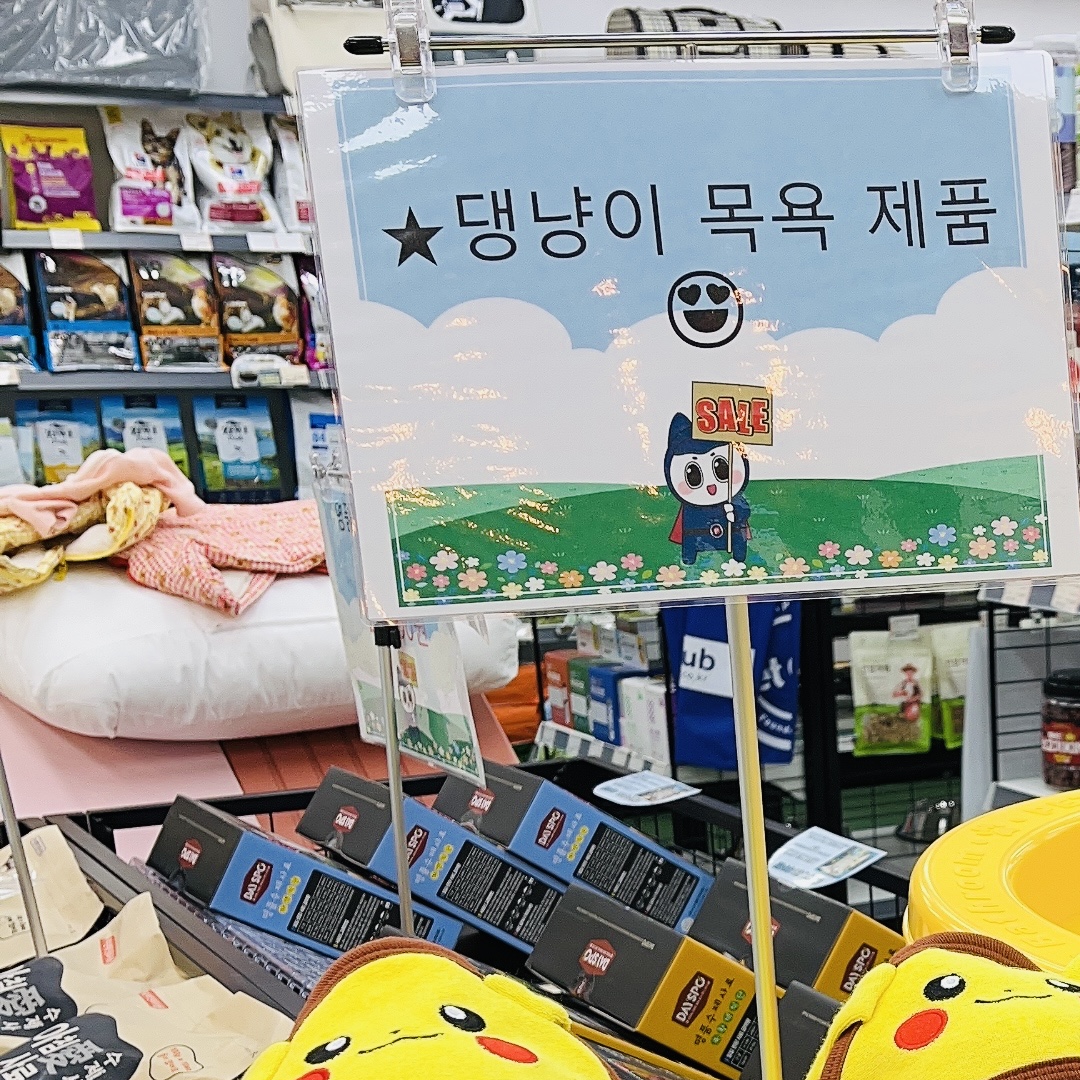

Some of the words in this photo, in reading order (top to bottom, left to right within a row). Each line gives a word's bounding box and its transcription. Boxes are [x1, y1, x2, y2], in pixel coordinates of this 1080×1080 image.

[454, 185, 665, 261] 댕냥이
[700, 179, 835, 253] 목욕
[867, 176, 998, 250] 제품
